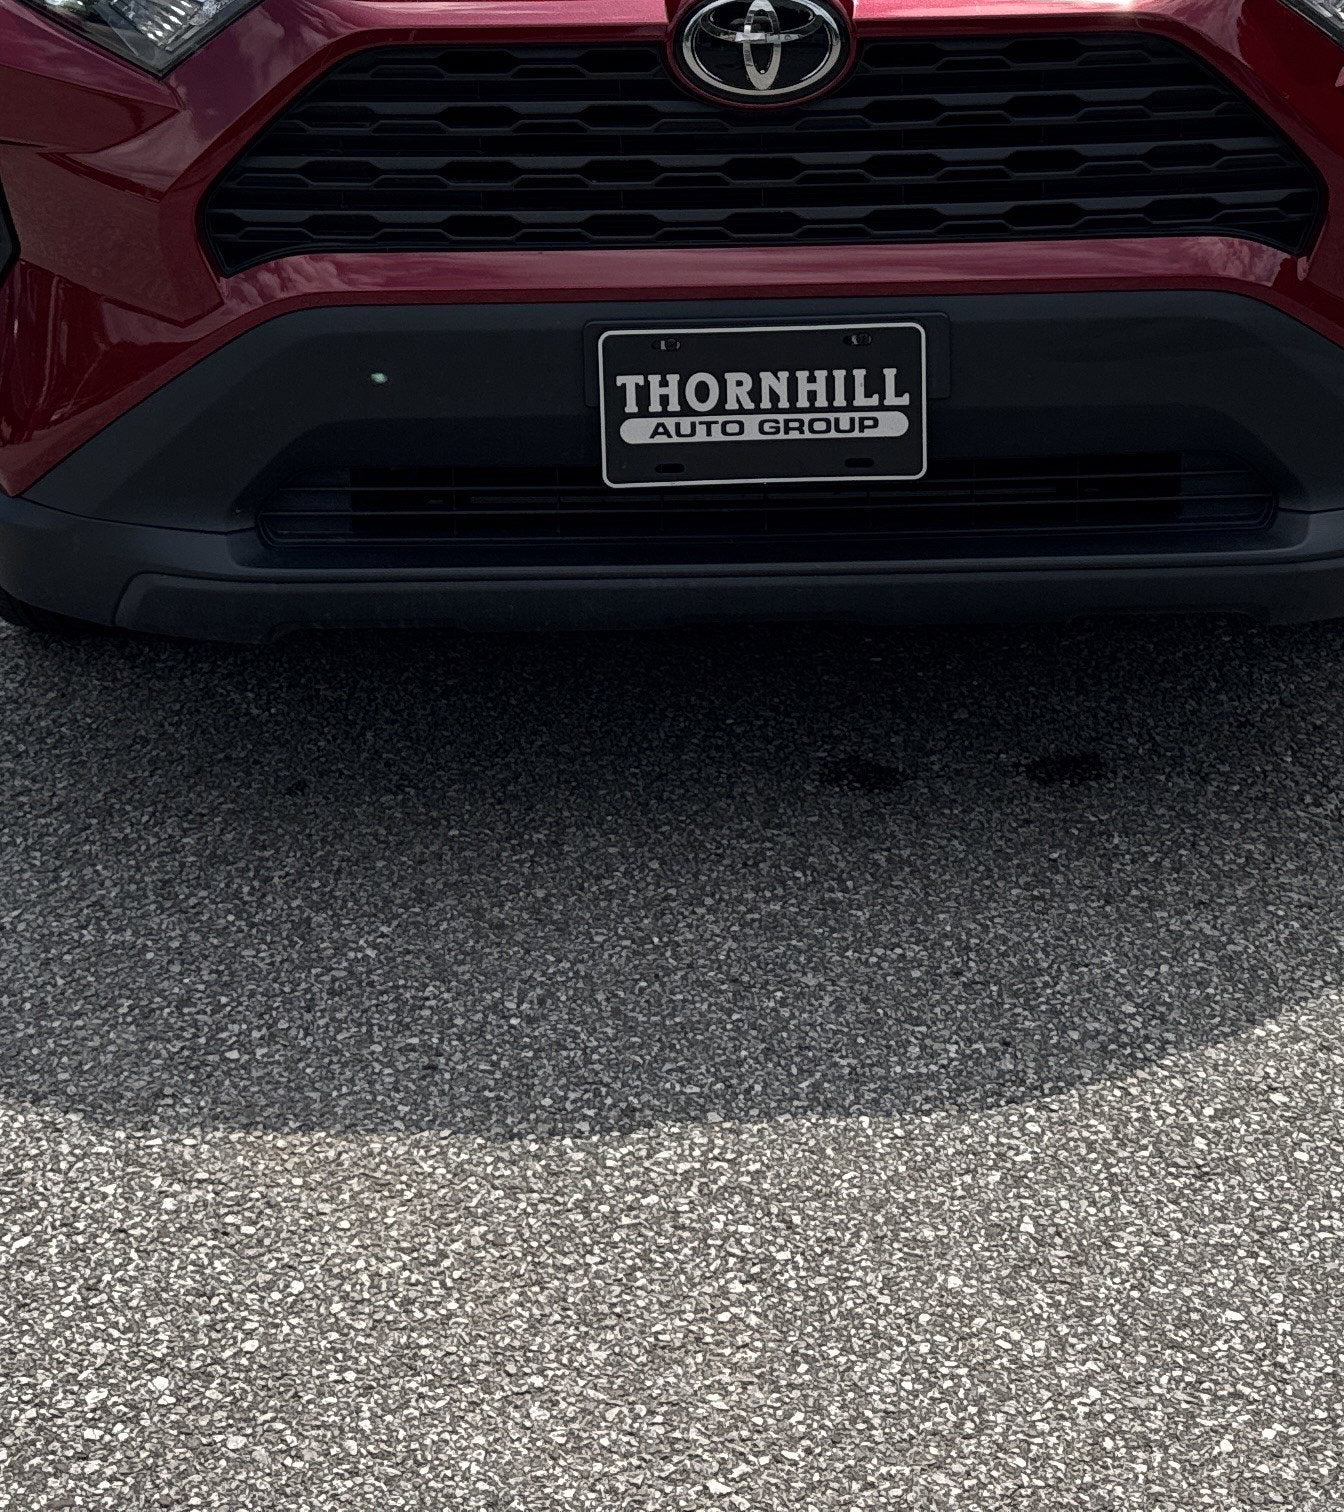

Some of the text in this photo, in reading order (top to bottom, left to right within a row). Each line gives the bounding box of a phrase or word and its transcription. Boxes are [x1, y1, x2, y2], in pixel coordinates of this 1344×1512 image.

[615, 367, 910, 414] THORNHILL
[649, 415, 880, 440] AUTO GROUP
